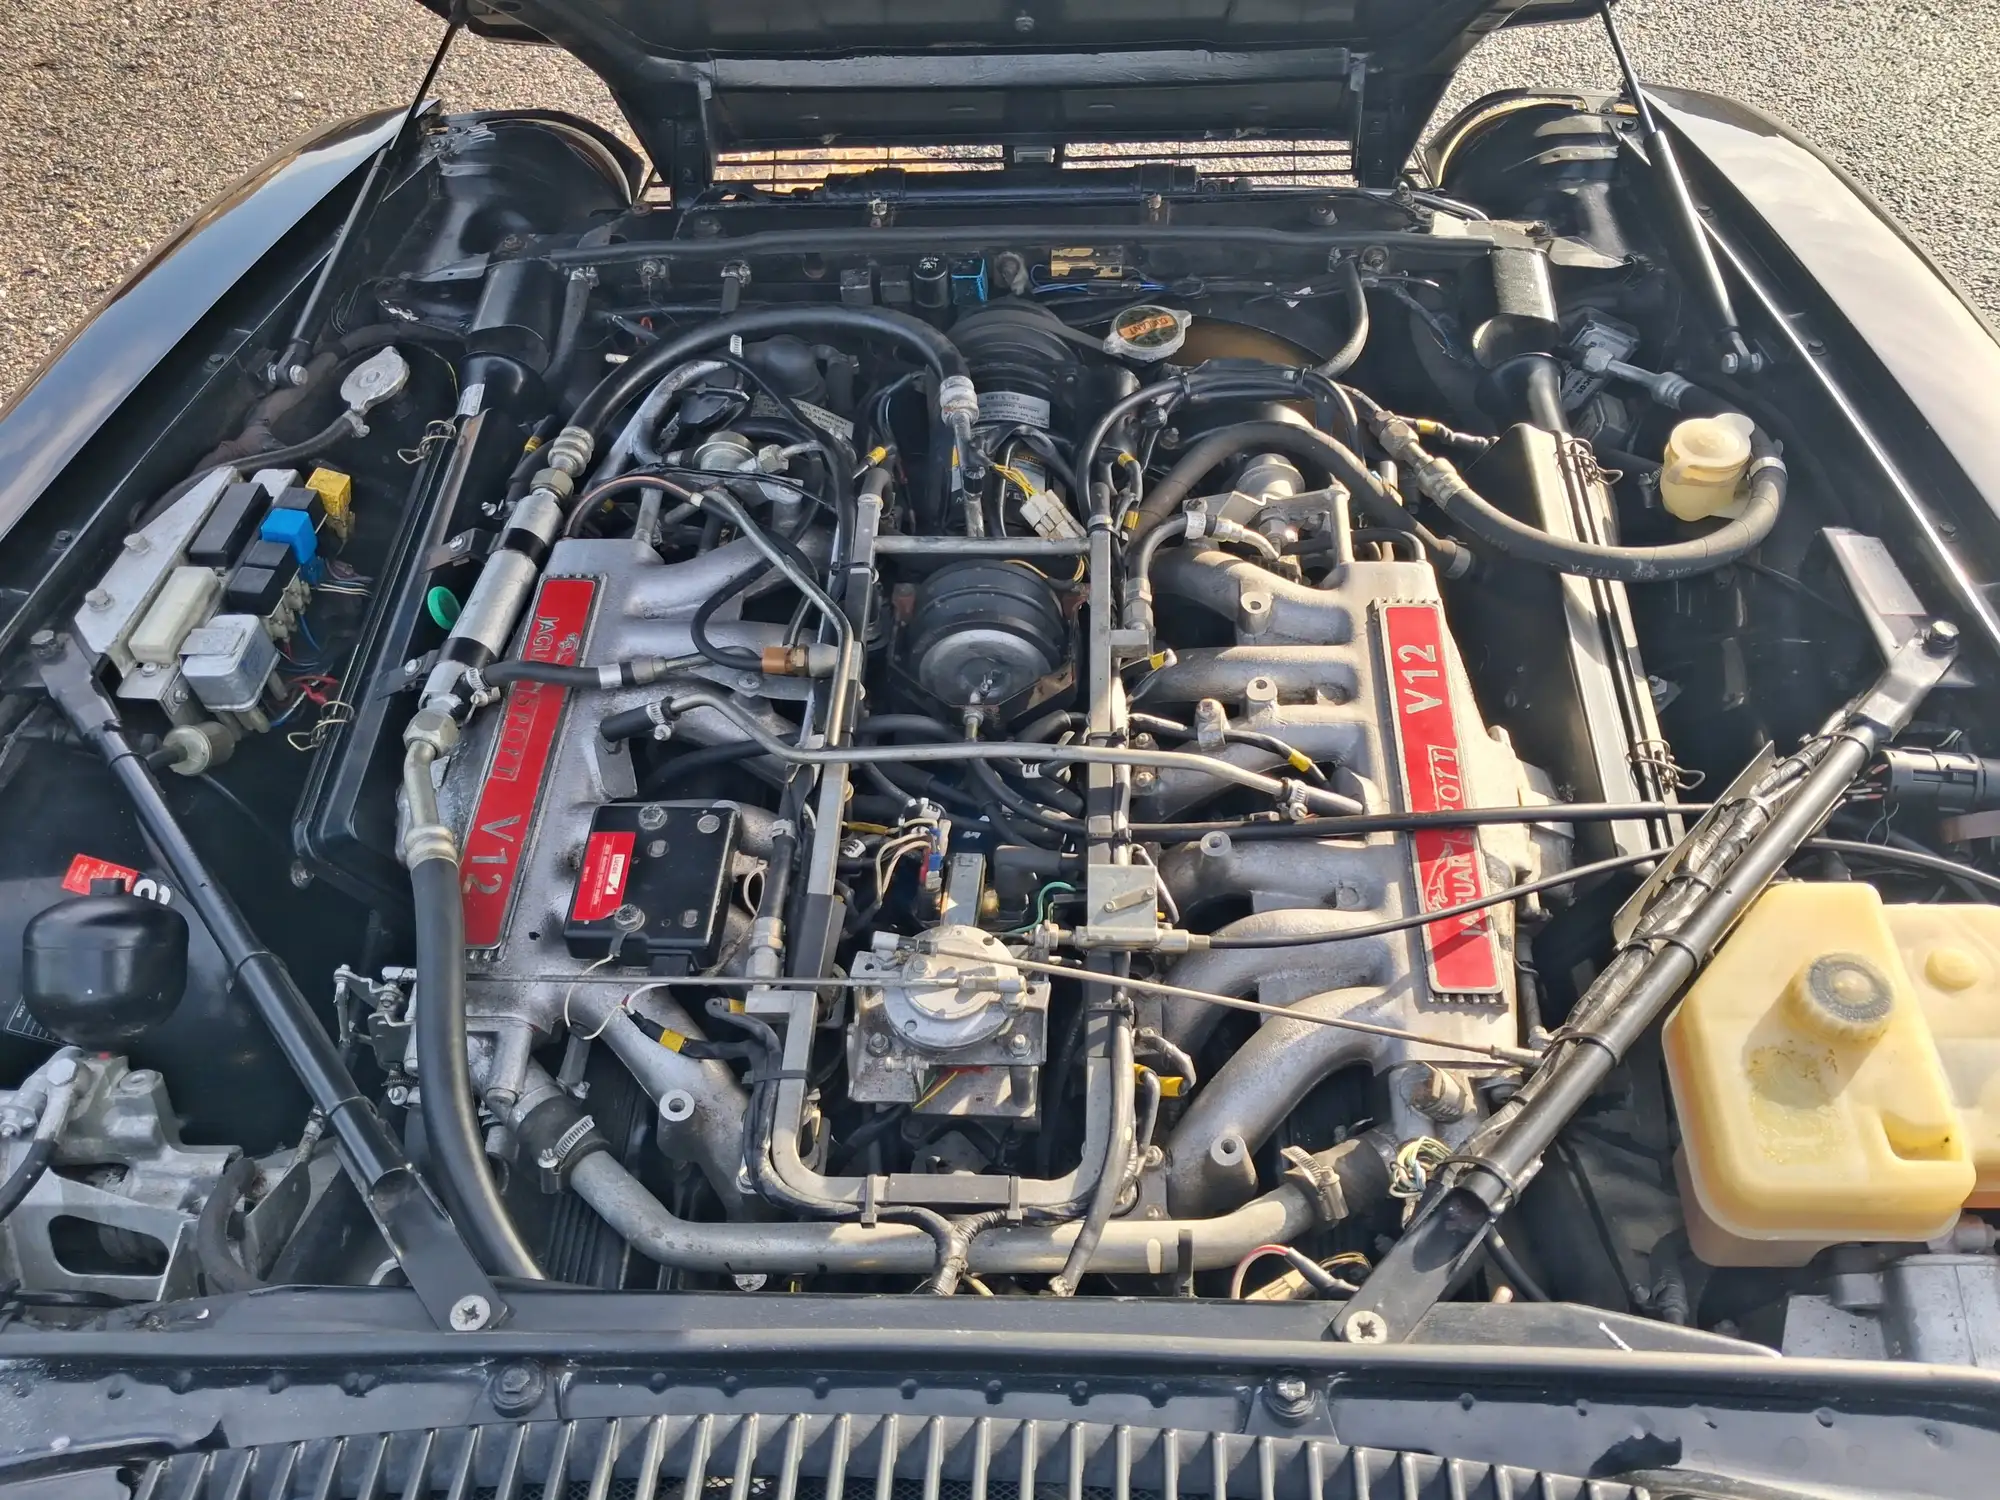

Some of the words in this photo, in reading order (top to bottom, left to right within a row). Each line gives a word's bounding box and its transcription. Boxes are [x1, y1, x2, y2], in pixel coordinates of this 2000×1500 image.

[1584, 567, 1620, 579] TYPE
[529, 616, 560, 663] JAGU
[1397, 645, 1443, 714] V12
[462, 815, 521, 894] V12
